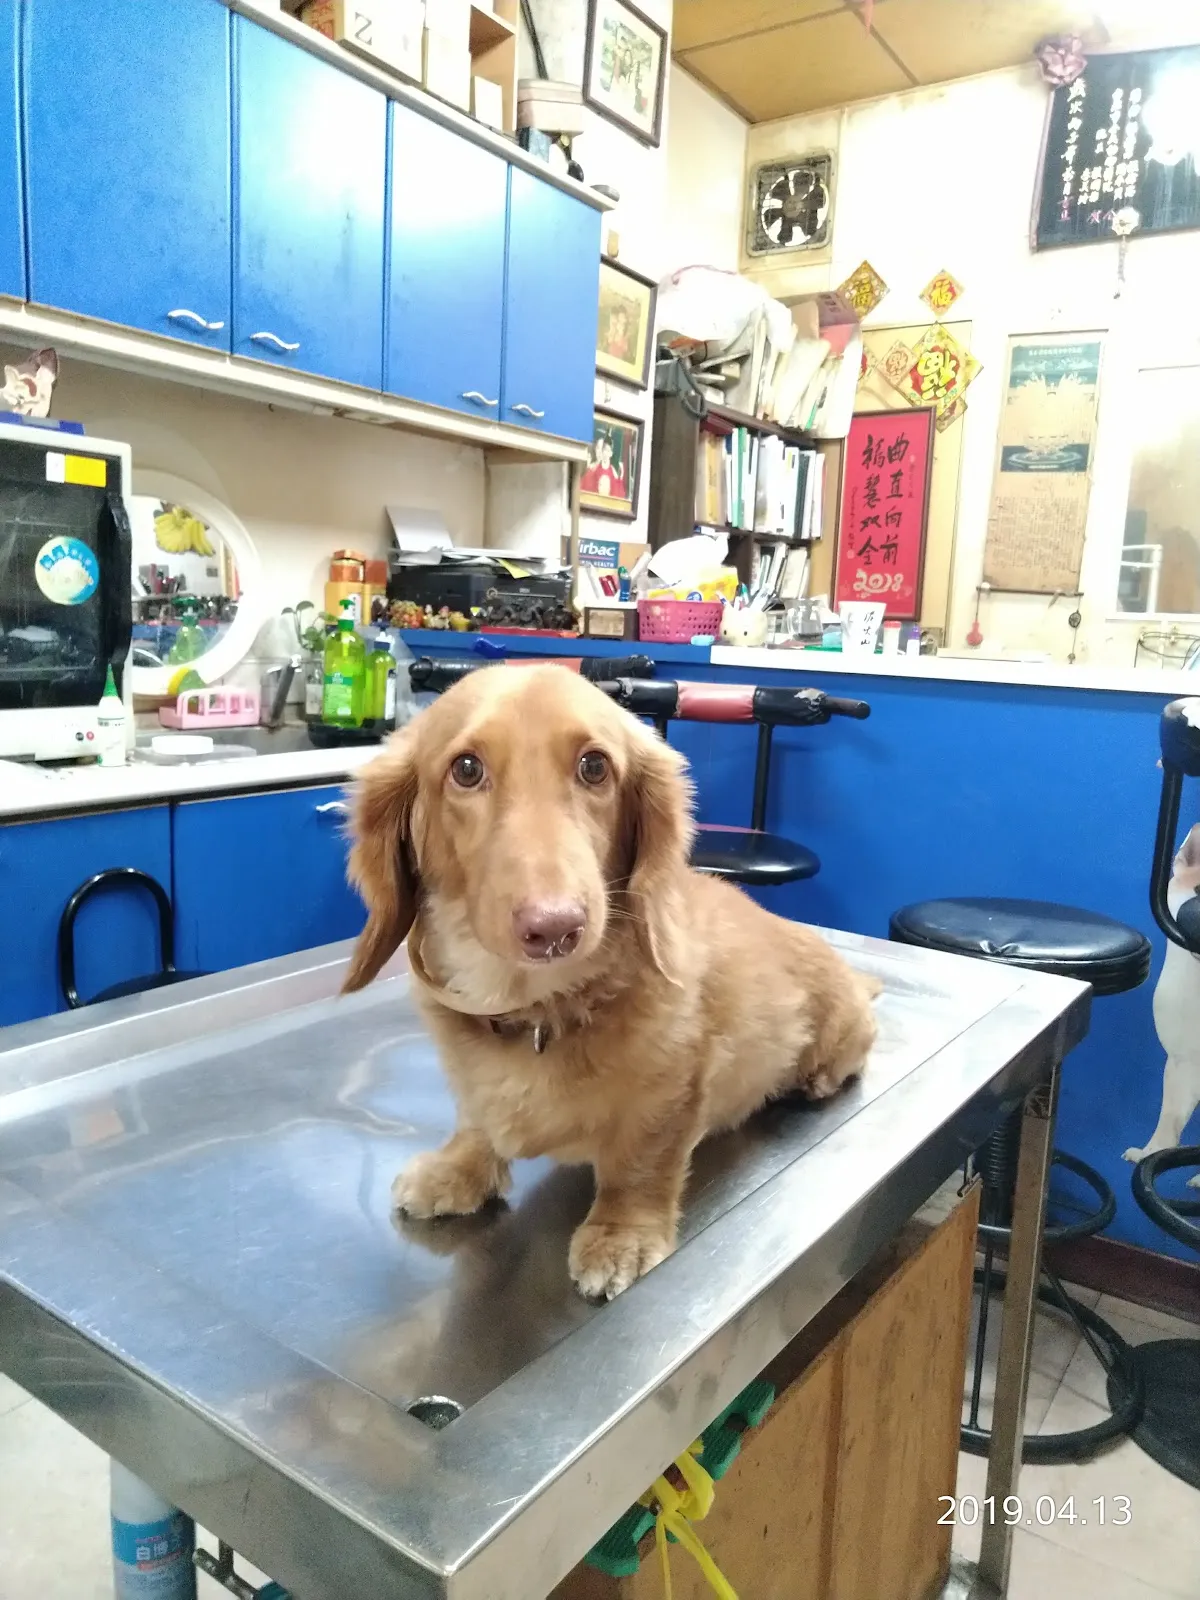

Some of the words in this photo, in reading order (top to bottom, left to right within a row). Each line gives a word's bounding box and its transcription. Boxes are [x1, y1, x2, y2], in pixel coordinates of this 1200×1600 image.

[880, 432, 910, 566] 曲直向前
[579, 541, 616, 557] irbac
[853, 568, 904, 594] 2018
